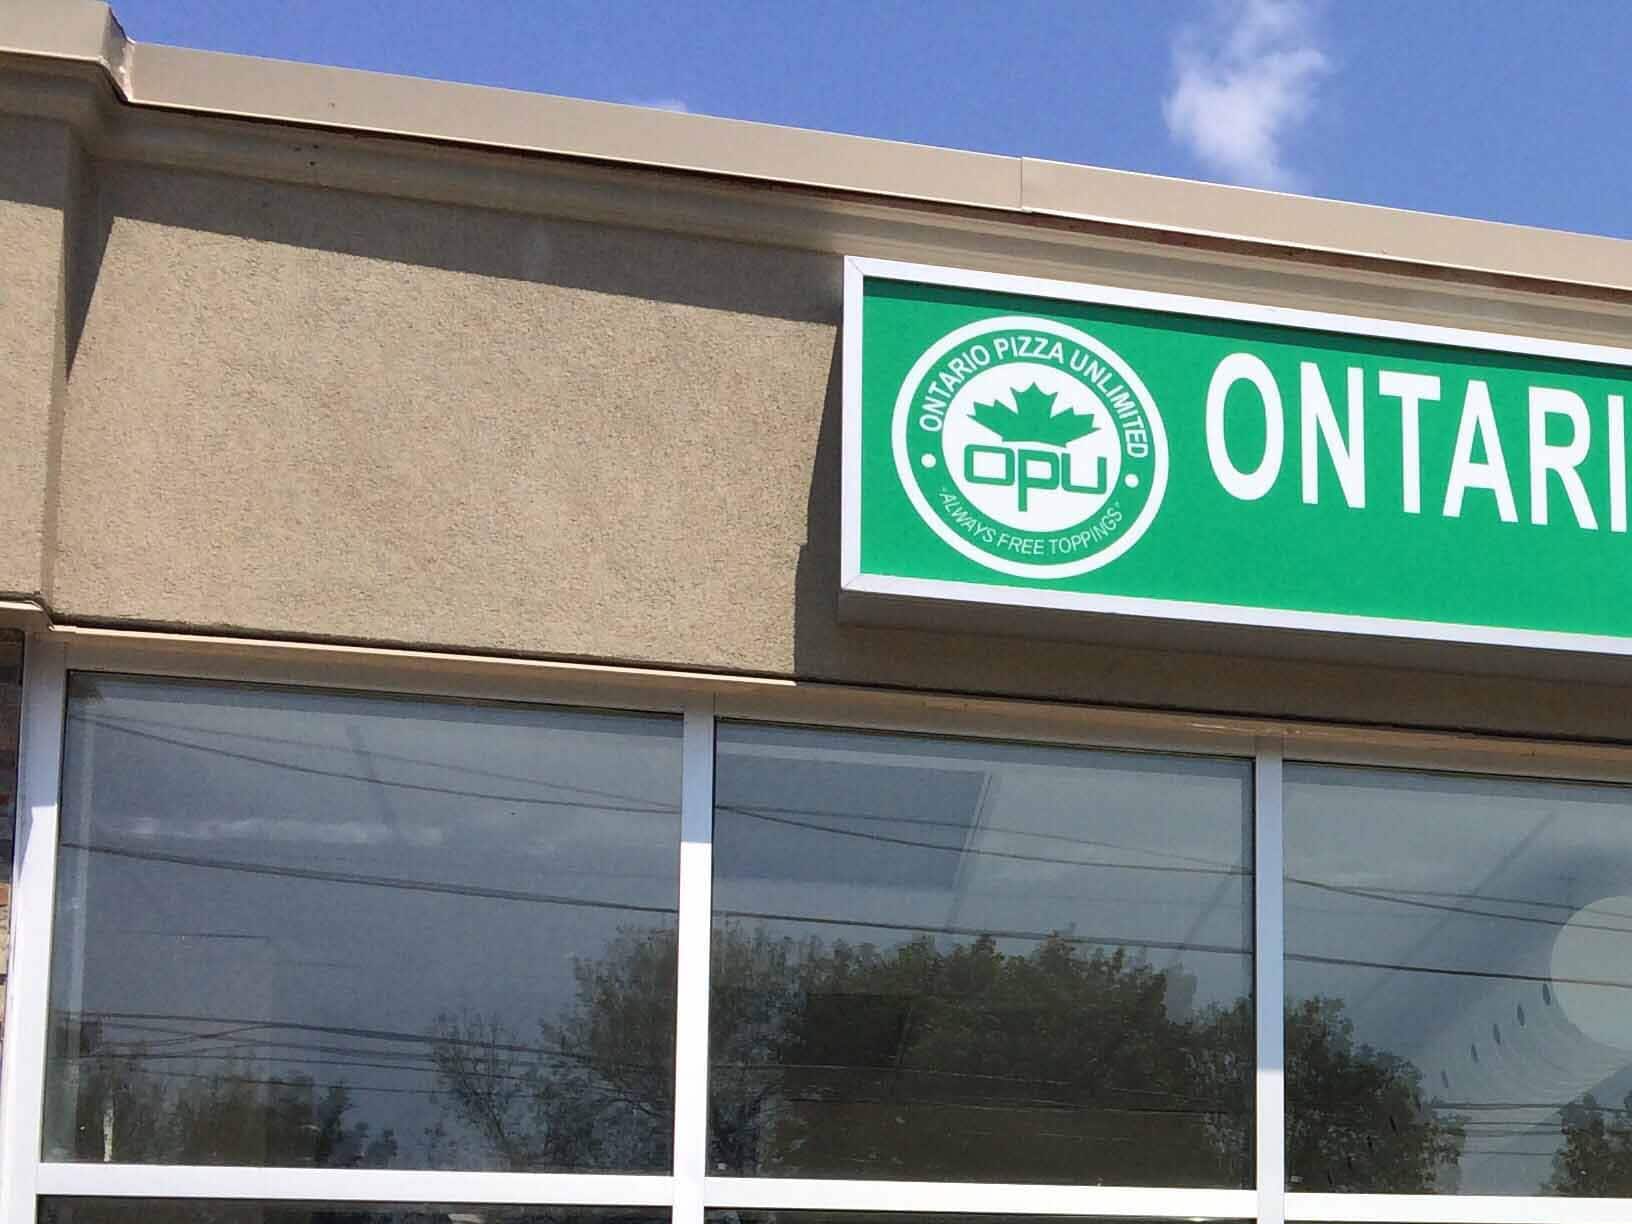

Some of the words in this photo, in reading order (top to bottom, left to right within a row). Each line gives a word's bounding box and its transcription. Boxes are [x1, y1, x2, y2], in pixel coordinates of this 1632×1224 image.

[919, 344, 991, 433] ONTARIO
[993, 335, 1065, 364] PIZZA
[1068, 349, 1149, 459] UNLIMITED
[996, 532, 1045, 556] FREE
